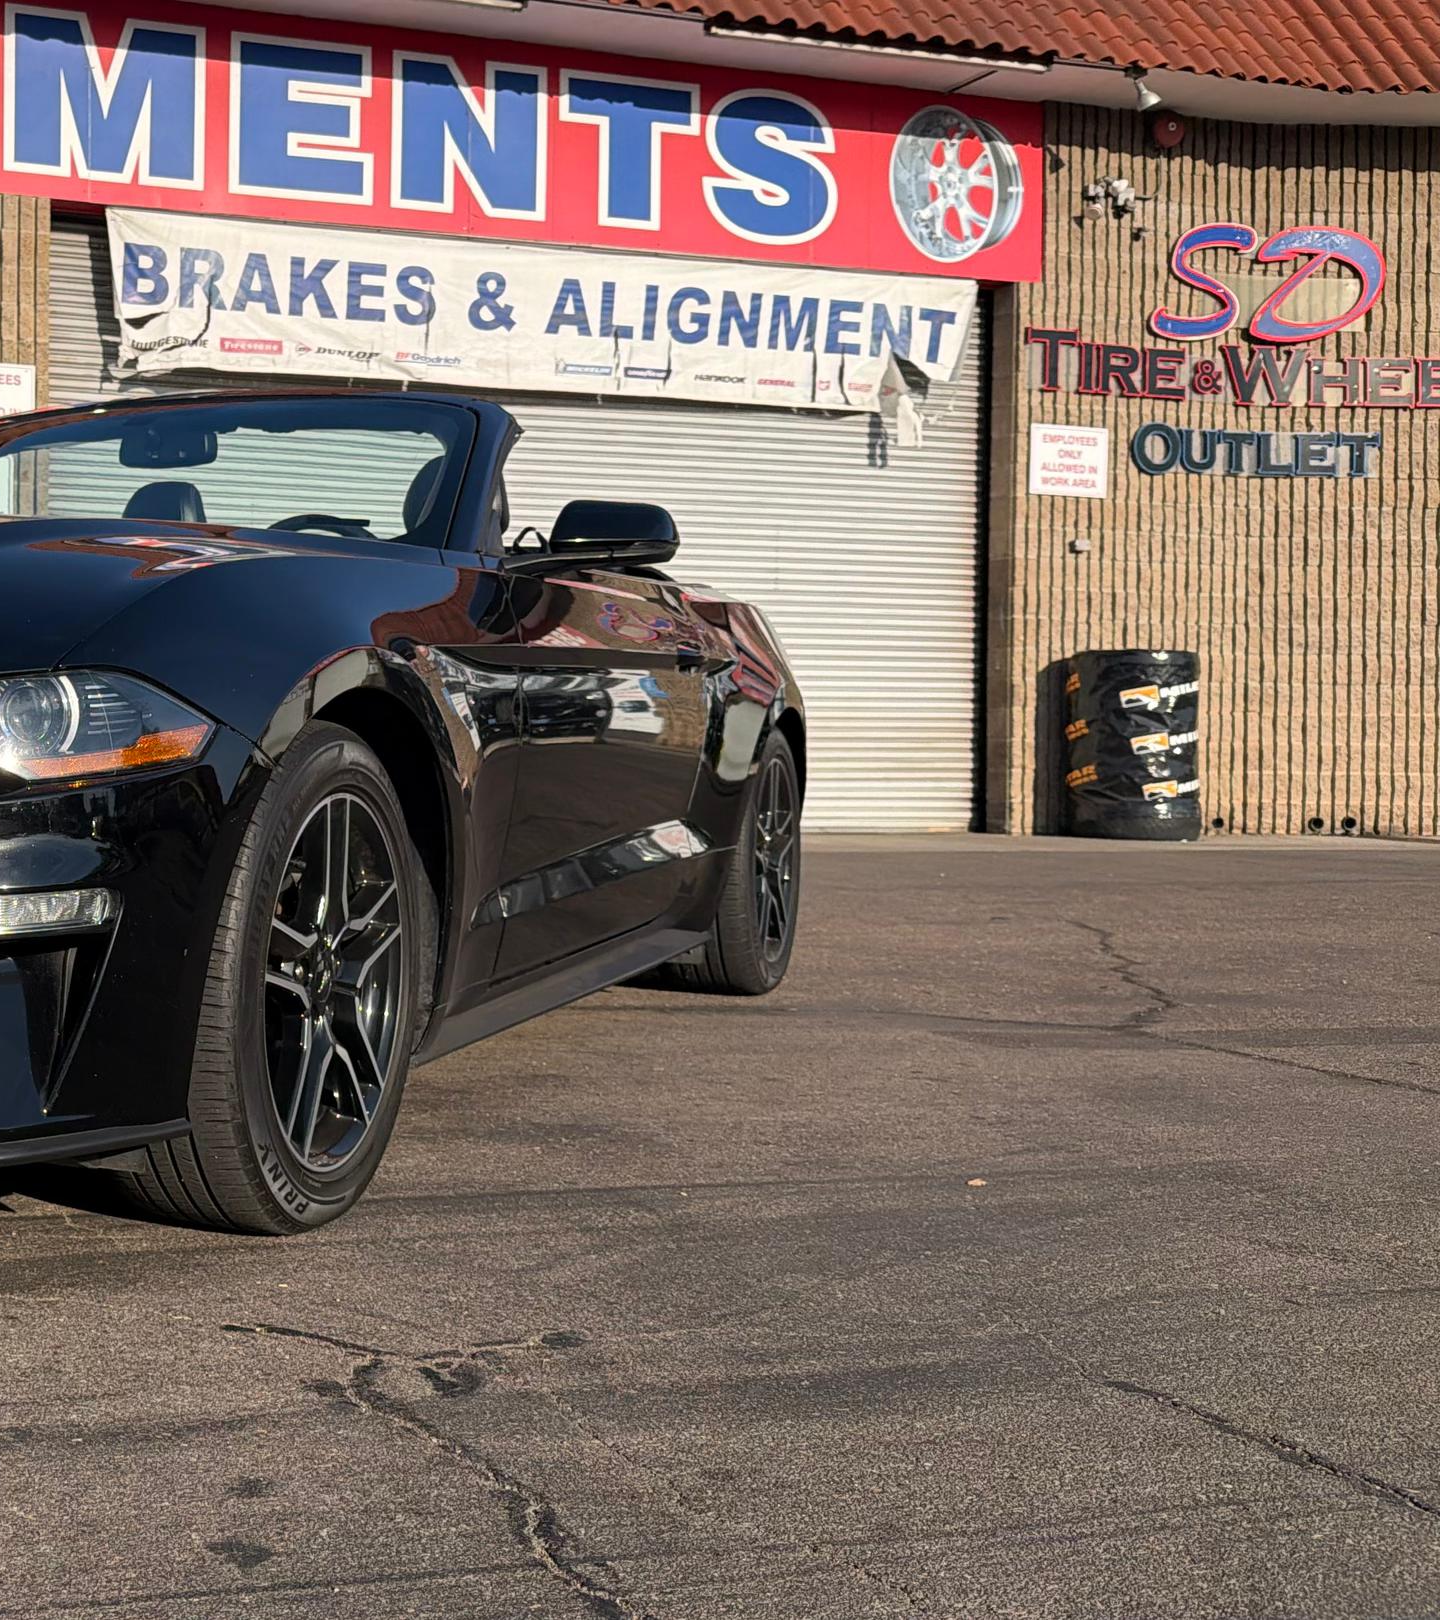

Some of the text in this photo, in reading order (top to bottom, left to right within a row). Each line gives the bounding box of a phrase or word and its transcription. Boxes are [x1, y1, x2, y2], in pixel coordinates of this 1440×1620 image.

[1149, 222, 1386, 342] SD
[123, 242, 957, 365] BRAKES & ALIGNMENT
[315, 346, 383, 361] DUNLOP
[1025, 327, 1188, 399] TIRE
[1192, 358, 1225, 396] &
[1042, 434, 1098, 446] EMPLOYEES
[1058, 449, 1082, 459] ONLY
[1131, 422, 1381, 477] OUTLET
[1041, 462, 1086, 474] ALLOWED
[1041, 477, 1097, 488] WORK AREA
